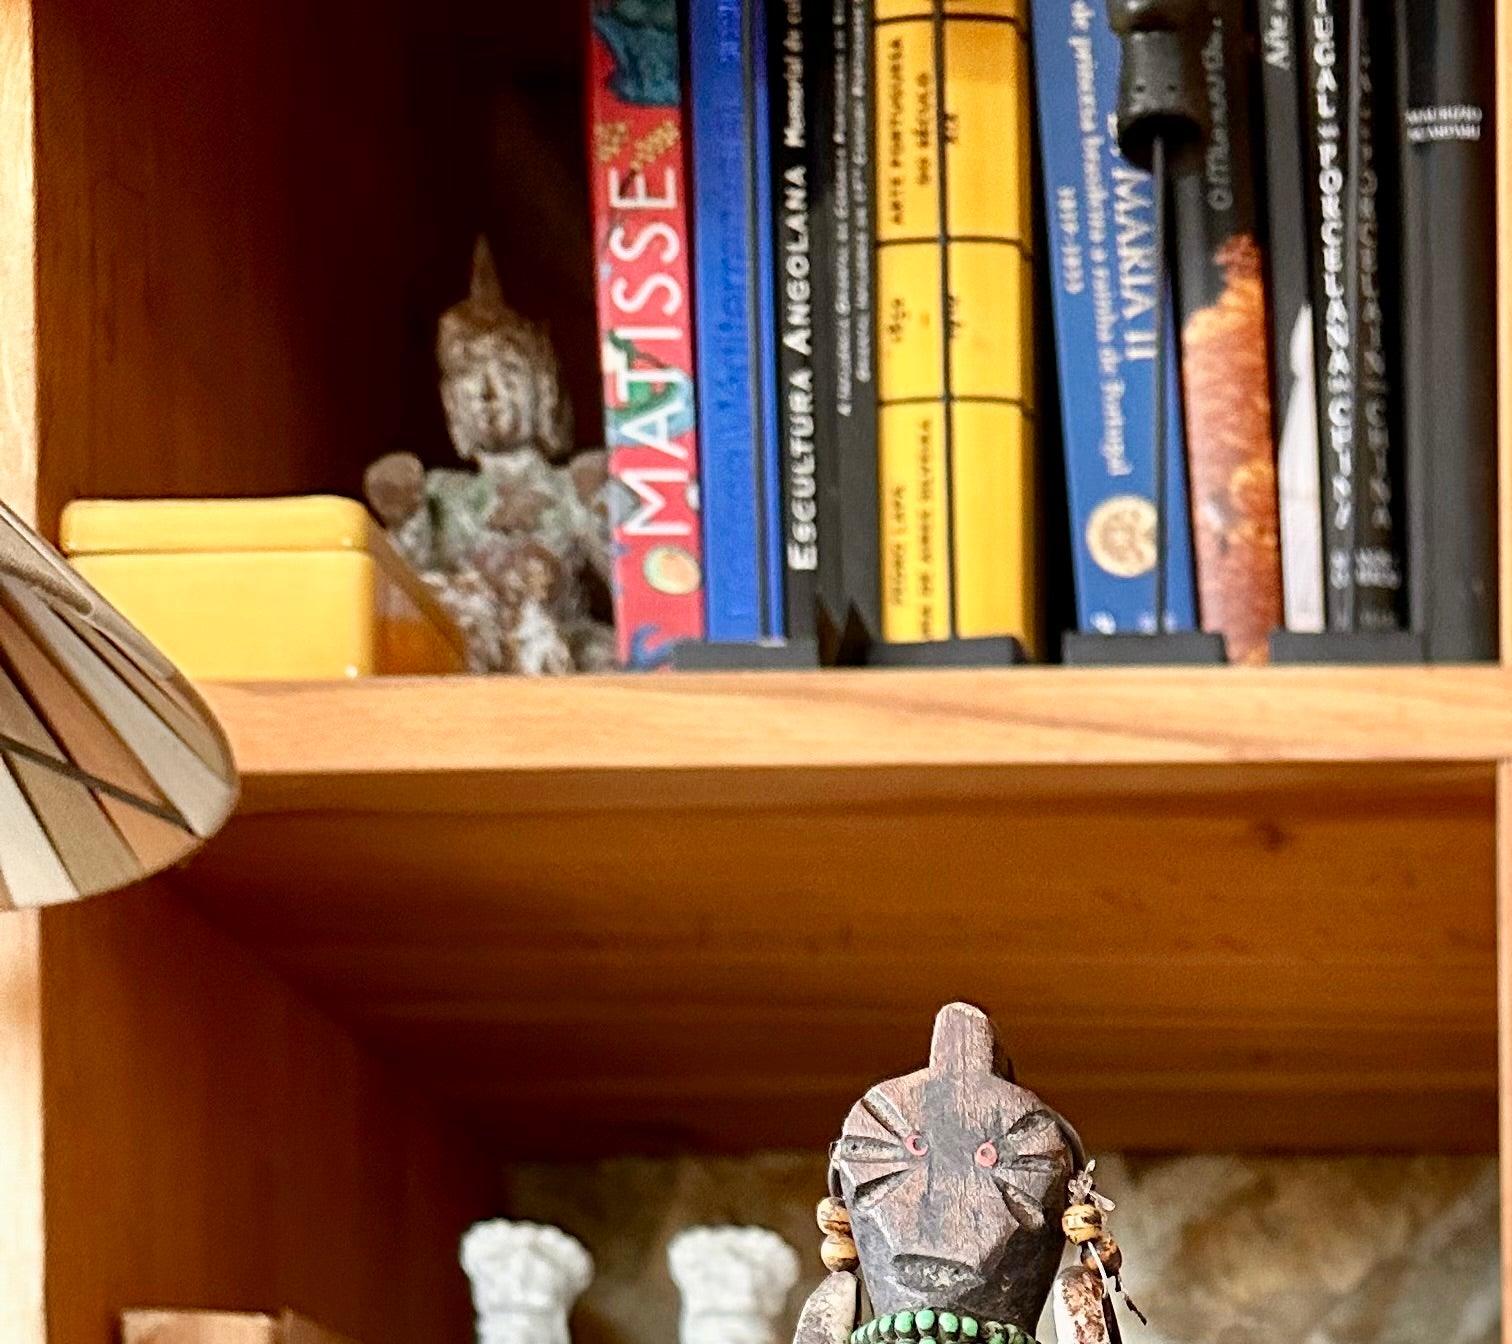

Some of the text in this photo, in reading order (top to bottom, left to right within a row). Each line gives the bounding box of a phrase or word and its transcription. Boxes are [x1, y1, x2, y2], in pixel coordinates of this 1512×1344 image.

[607, 166, 691, 536] MATISSE
[782, 165, 812, 356] ANGOLANA
[1112, 167, 1158, 361] MARIA II
[786, 368, 818, 571] ESCULTURA
